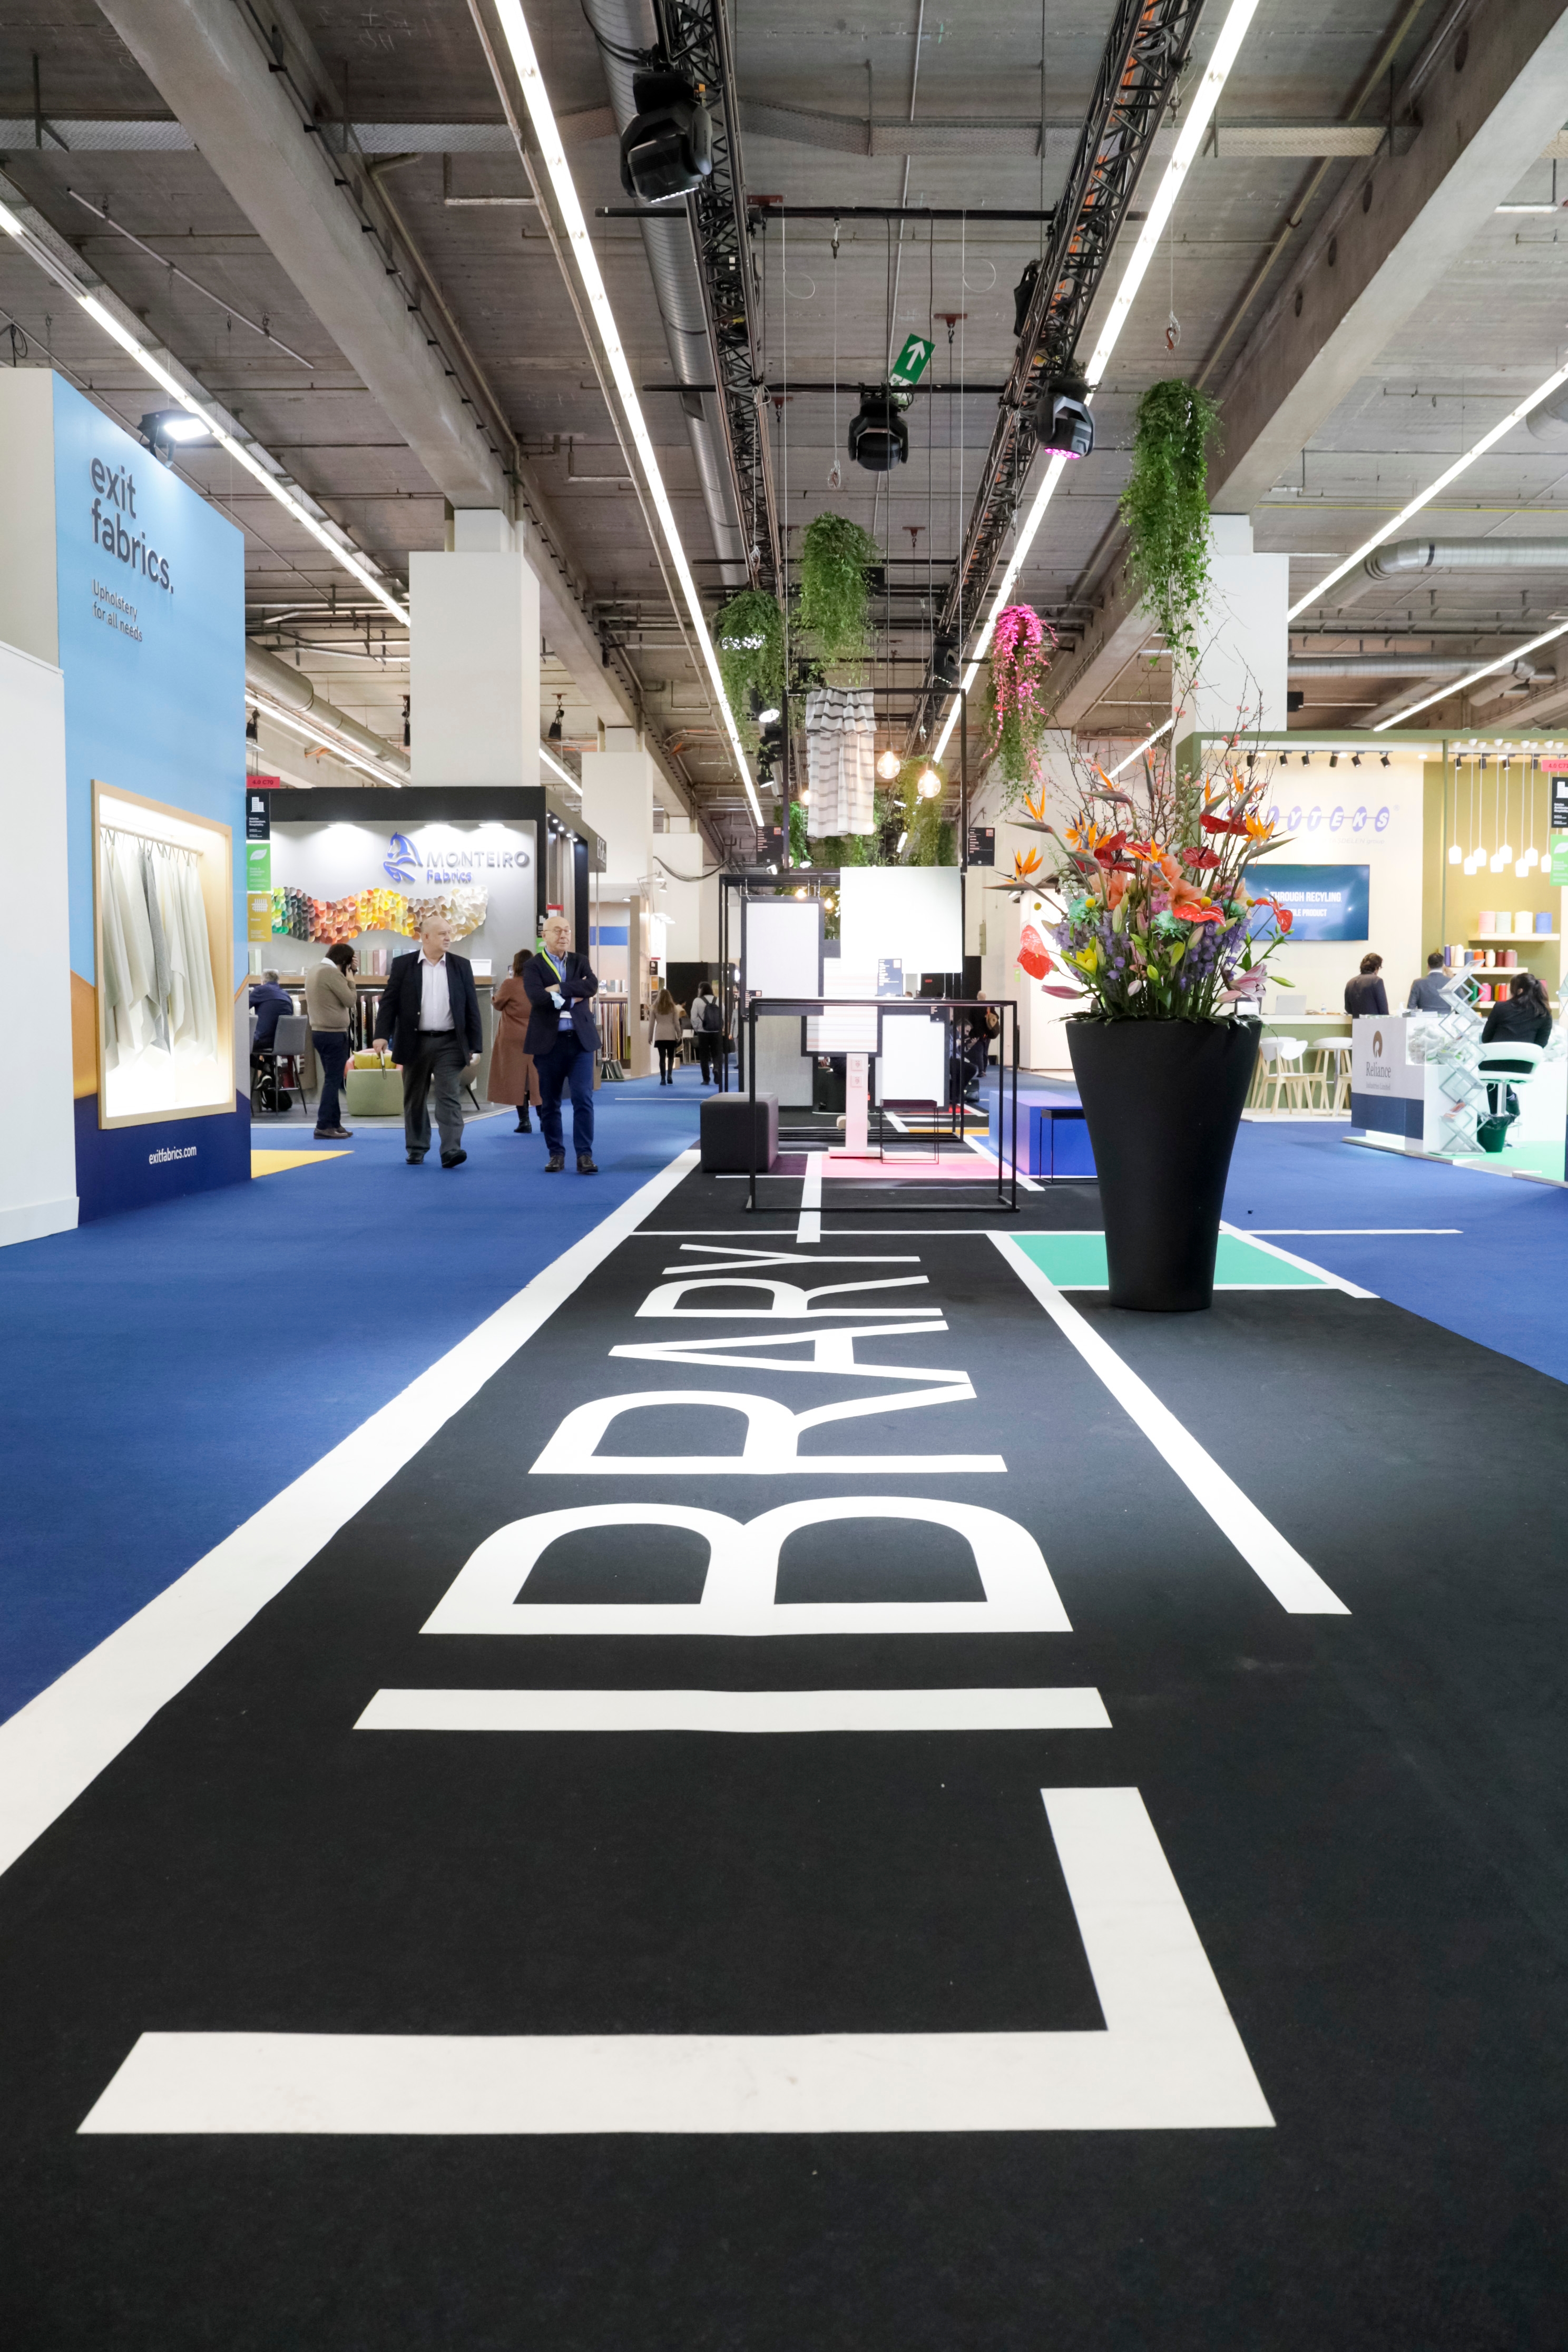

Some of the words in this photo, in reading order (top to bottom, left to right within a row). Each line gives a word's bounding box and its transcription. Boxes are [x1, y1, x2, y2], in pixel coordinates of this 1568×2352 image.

[90, 457, 136, 520] exit
[90, 497, 174, 594] fabrics.
[92, 579, 138, 623] Upholstery
[92, 601, 106, 621] for
[106, 612, 118, 629] all
[119, 620, 143, 642] needs
[427, 851, 530, 867] MONTEIRO
[427, 869, 472, 882] Fabrics
[1270, 891, 1305, 901] THROUGH
[1302, 908, 1328, 917] PRODUCT
[1366, 1062, 1391, 1078] Reliance
[149, 1146, 197, 1165] exitfabrics.com
[78, 1242, 1276, 2135] LIBRARY
